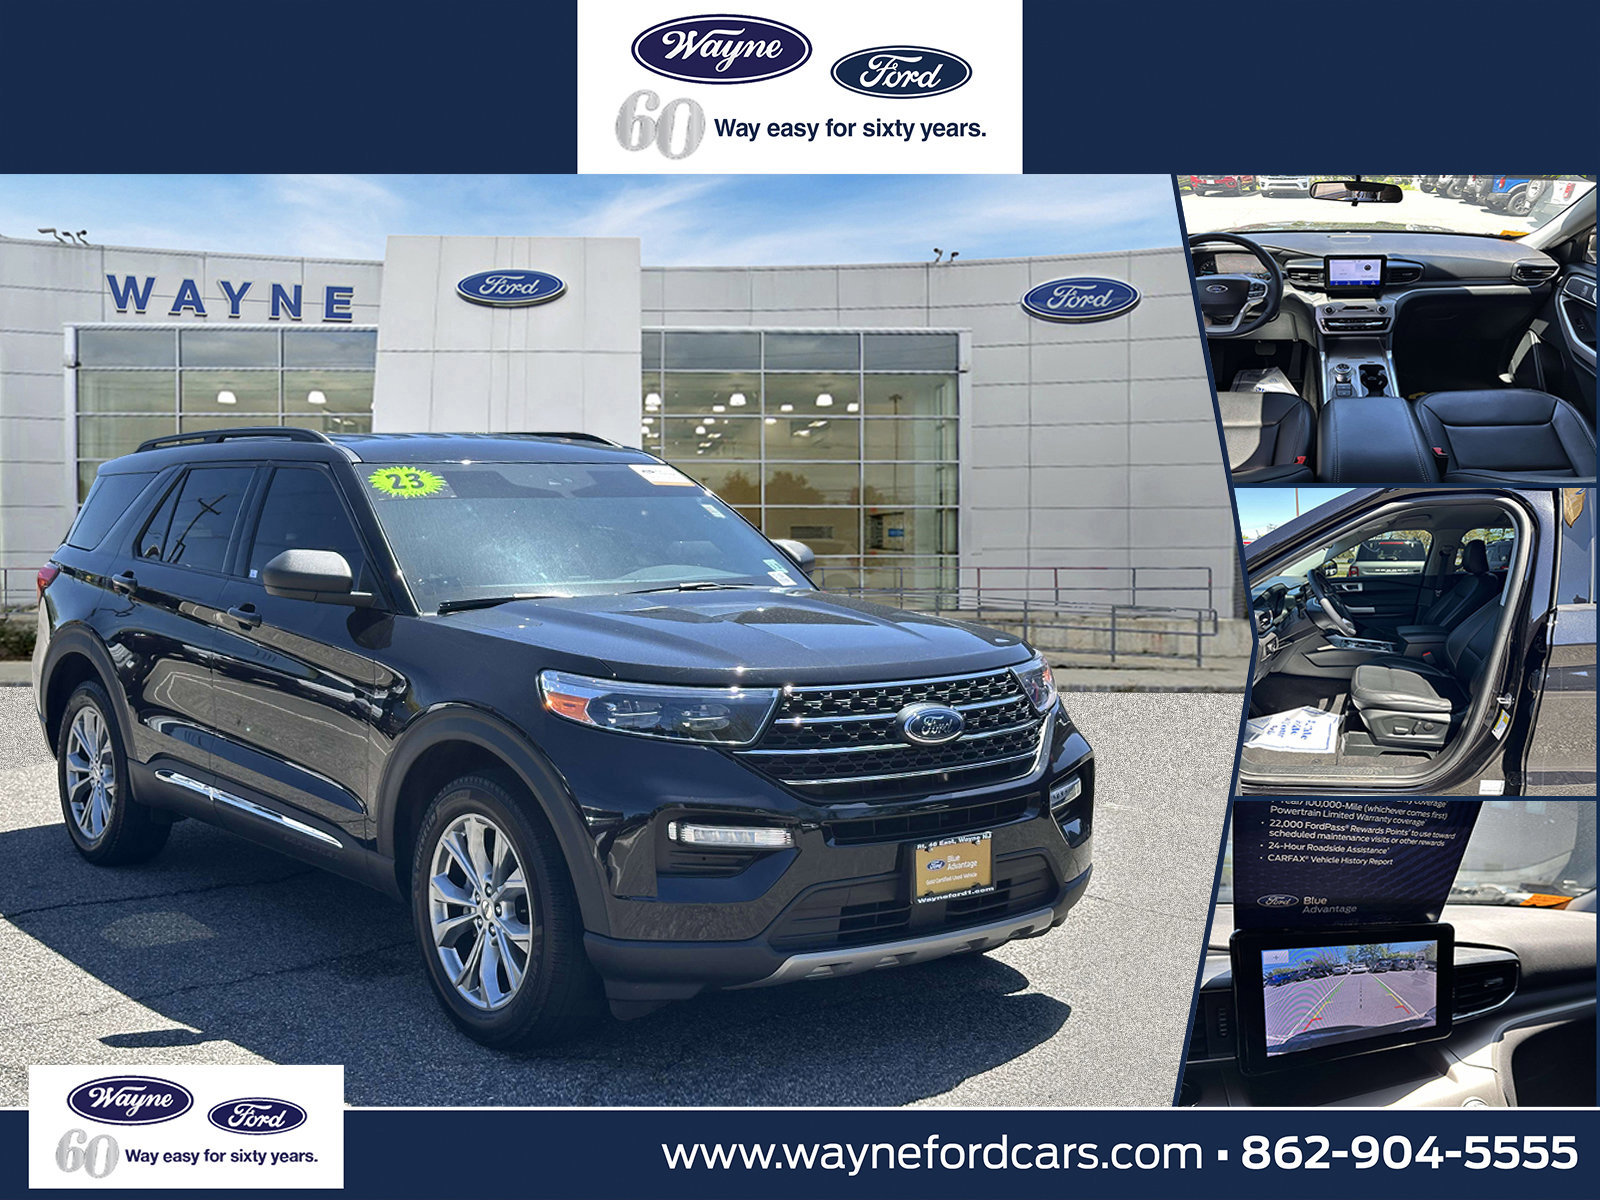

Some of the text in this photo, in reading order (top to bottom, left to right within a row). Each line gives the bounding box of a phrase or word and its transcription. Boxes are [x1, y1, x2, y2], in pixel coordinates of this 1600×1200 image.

[479, 274, 540, 294] Ford
[105, 273, 355, 323] WAYNE
[1046, 284, 1114, 309] Ford
[386, 472, 424, 490] 23
[921, 716, 953, 735] Ford
[1270, 805, 1321, 817] Powertrain
[1323, 810, 1355, 820] Limited
[1356, 813, 1392, 824] Warranty
[1406, 810, 1431, 818] comes
[1269, 819, 1304, 828] 22,000
[1350, 825, 1384, 835] Rewards
[958, 835, 981, 843] Wayne
[1269, 829, 1316, 839] scheduled
[1317, 834, 1370, 843] maintenance
[1418, 839, 1445, 847] rewards
[1268, 842, 1305, 851] 24-Hour
[1307, 844, 1345, 853] Roadside
[948, 861, 977, 870] Advantage
[1311, 855, 1340, 864] Vehicle
[1341, 857, 1368, 866] History
[1368, 857, 1393, 866] Report
[1265, 896, 1291, 906] Ford
[1303, 896, 1327, 905] Blue
[1302, 905, 1358, 914] Advantage
